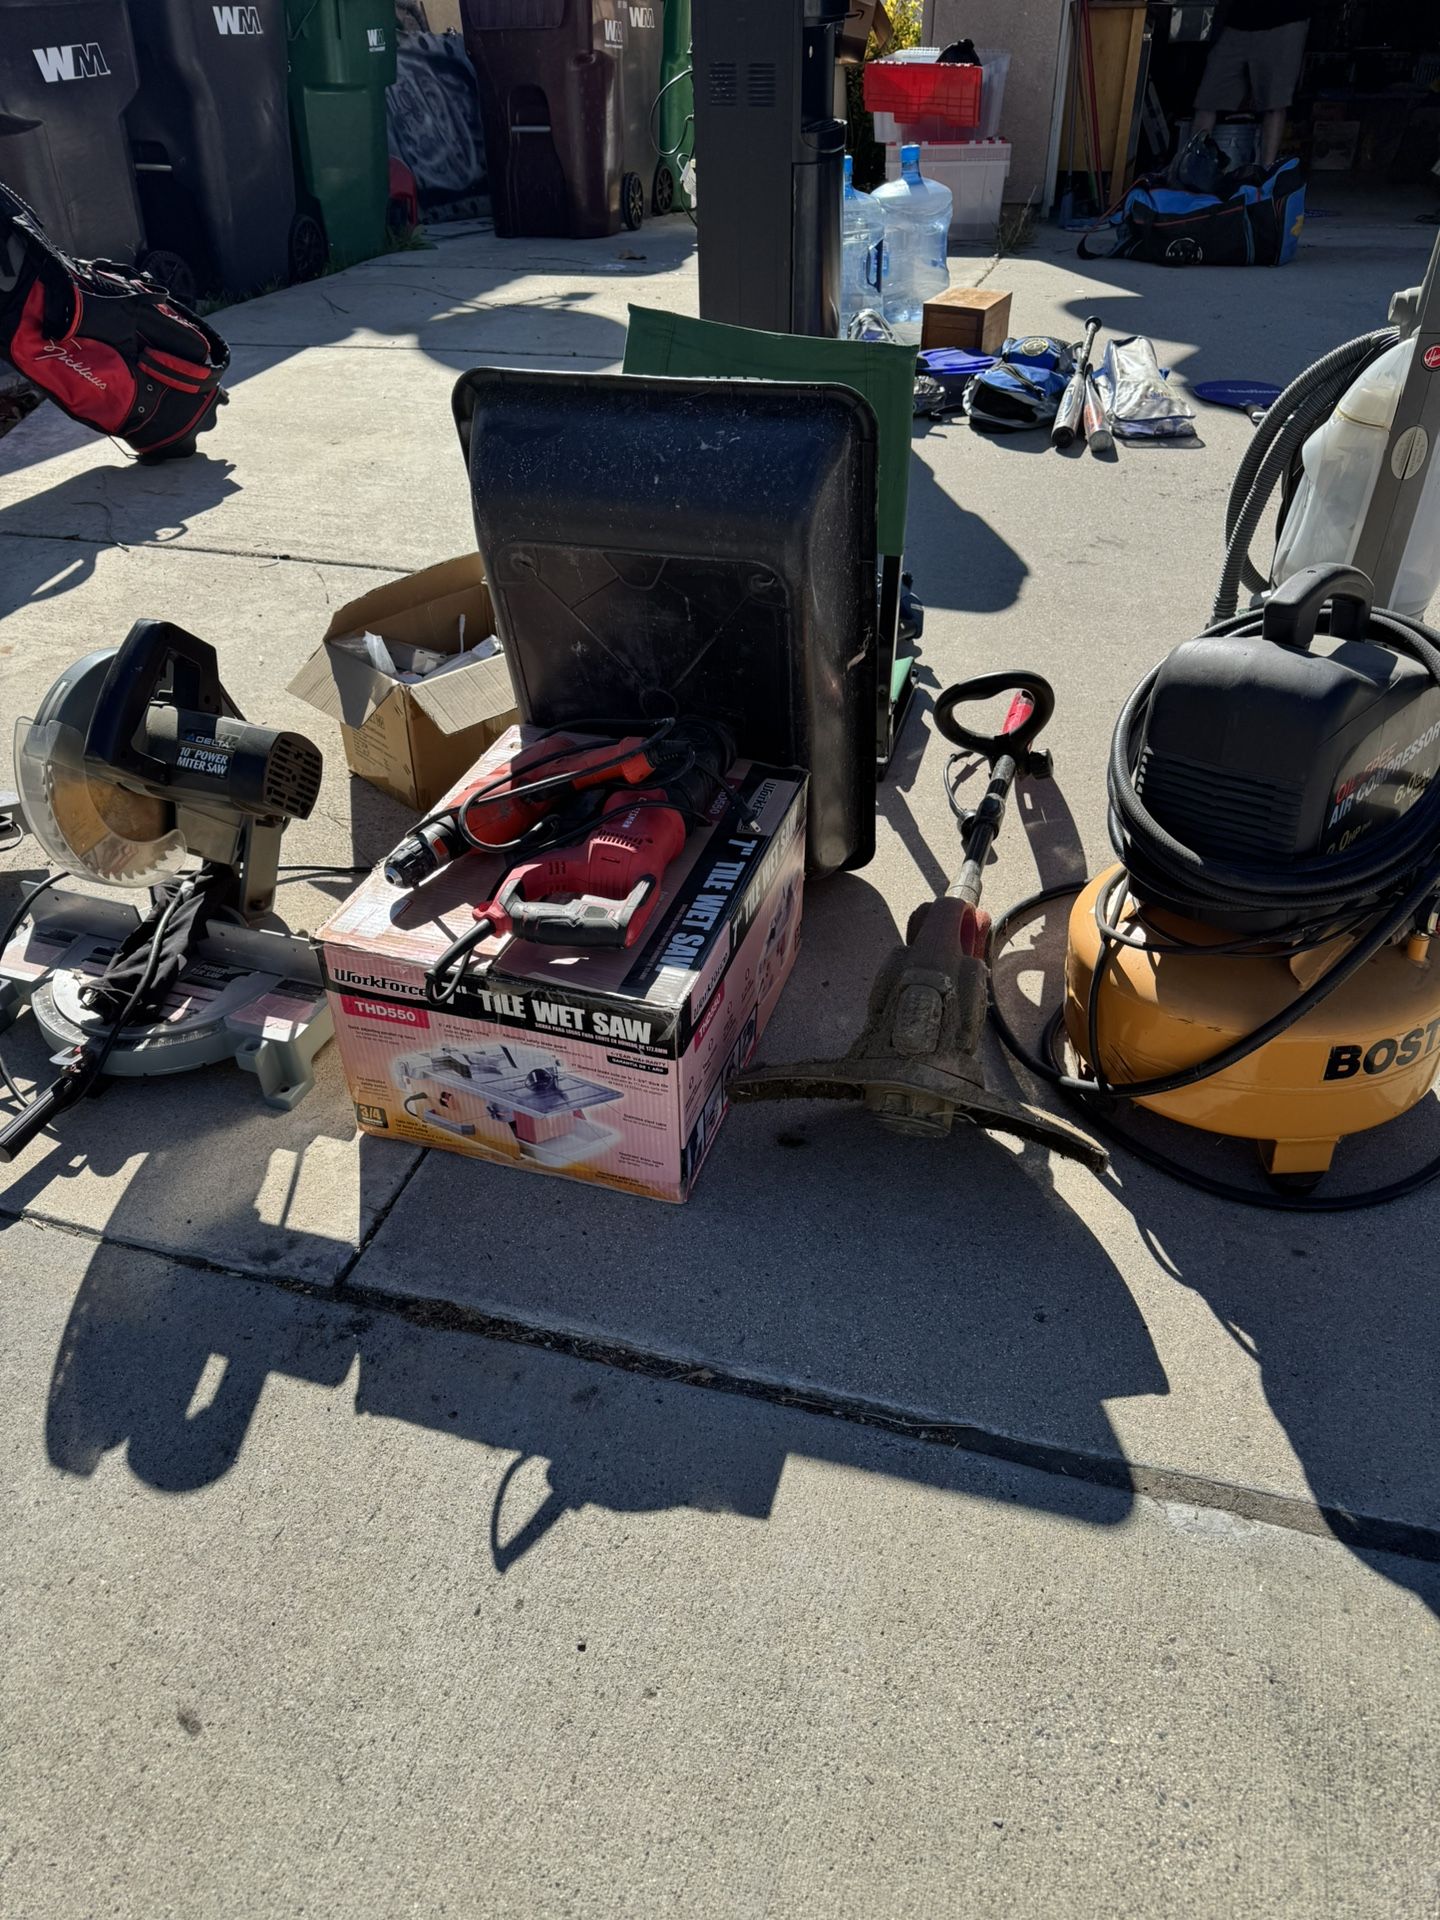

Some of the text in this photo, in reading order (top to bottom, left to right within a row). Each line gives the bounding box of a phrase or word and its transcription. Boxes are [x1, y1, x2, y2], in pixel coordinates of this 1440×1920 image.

[212, 5, 264, 36] WM
[629, 6, 656, 29] WM
[32, 42, 111, 83] WM
[34, 337, 107, 391] Nicklaus
[194, 749, 229, 765] POWER
[195, 735, 230, 749] DELTA
[176, 756, 228, 775] MITER SAW
[1328, 792, 1355, 830] AIR
[703, 861, 746, 891] TILE
[681, 894, 729, 931] WET
[334, 967, 427, 998] WorkForce
[354, 1000, 416, 1023] THD550
[477, 989, 527, 1019] TILE
[531, 999, 586, 1031] WET
[592, 1012, 652, 1045] SAW
[1322, 1017, 1440, 1081] BOST
